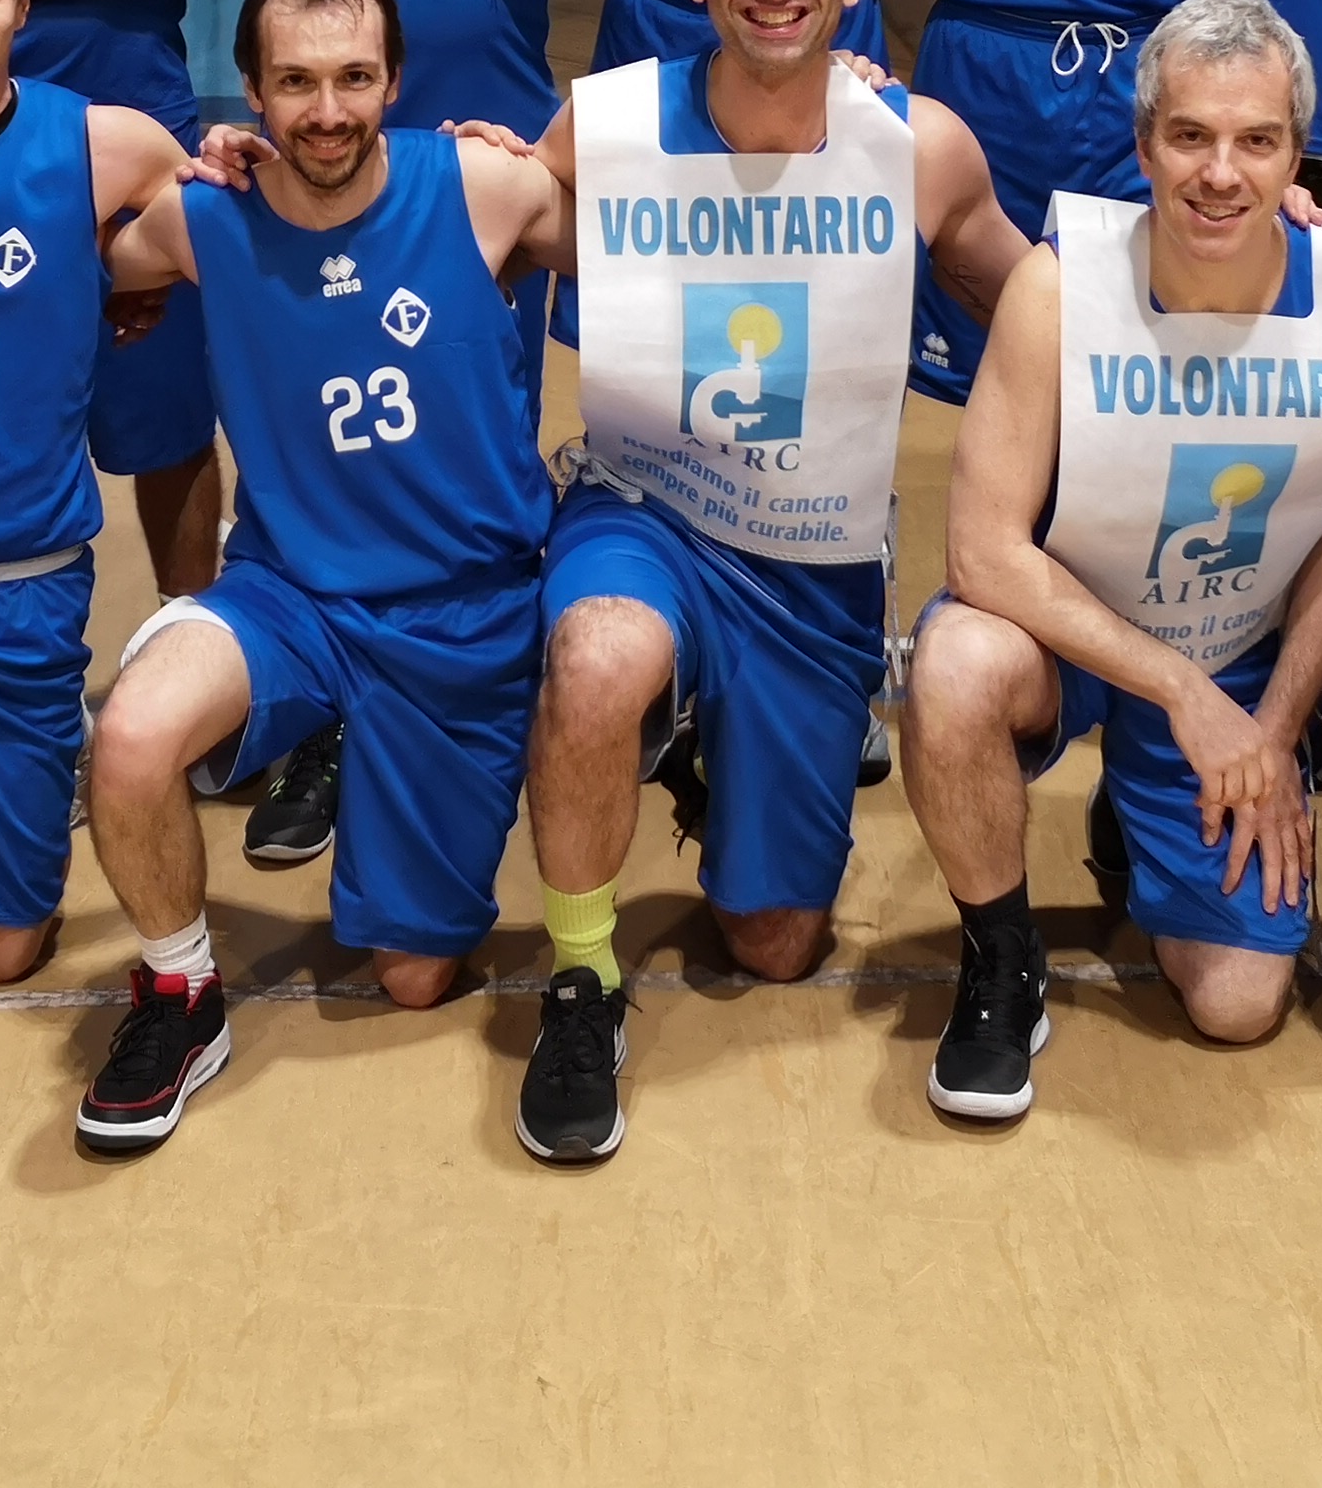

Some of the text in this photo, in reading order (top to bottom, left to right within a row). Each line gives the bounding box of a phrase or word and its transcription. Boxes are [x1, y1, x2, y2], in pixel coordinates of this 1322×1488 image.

[598, 195, 894, 256] VOLONTARIO
[323, 278, 362, 297] errea
[921, 350, 950, 369] errea
[321, 366, 417, 453] 23
[622, 453, 849, 543] sempre più curabile.
[743, 487, 761, 509] il
[768, 495, 849, 513] cancro
[1137, 567, 1257, 604] AIRC
